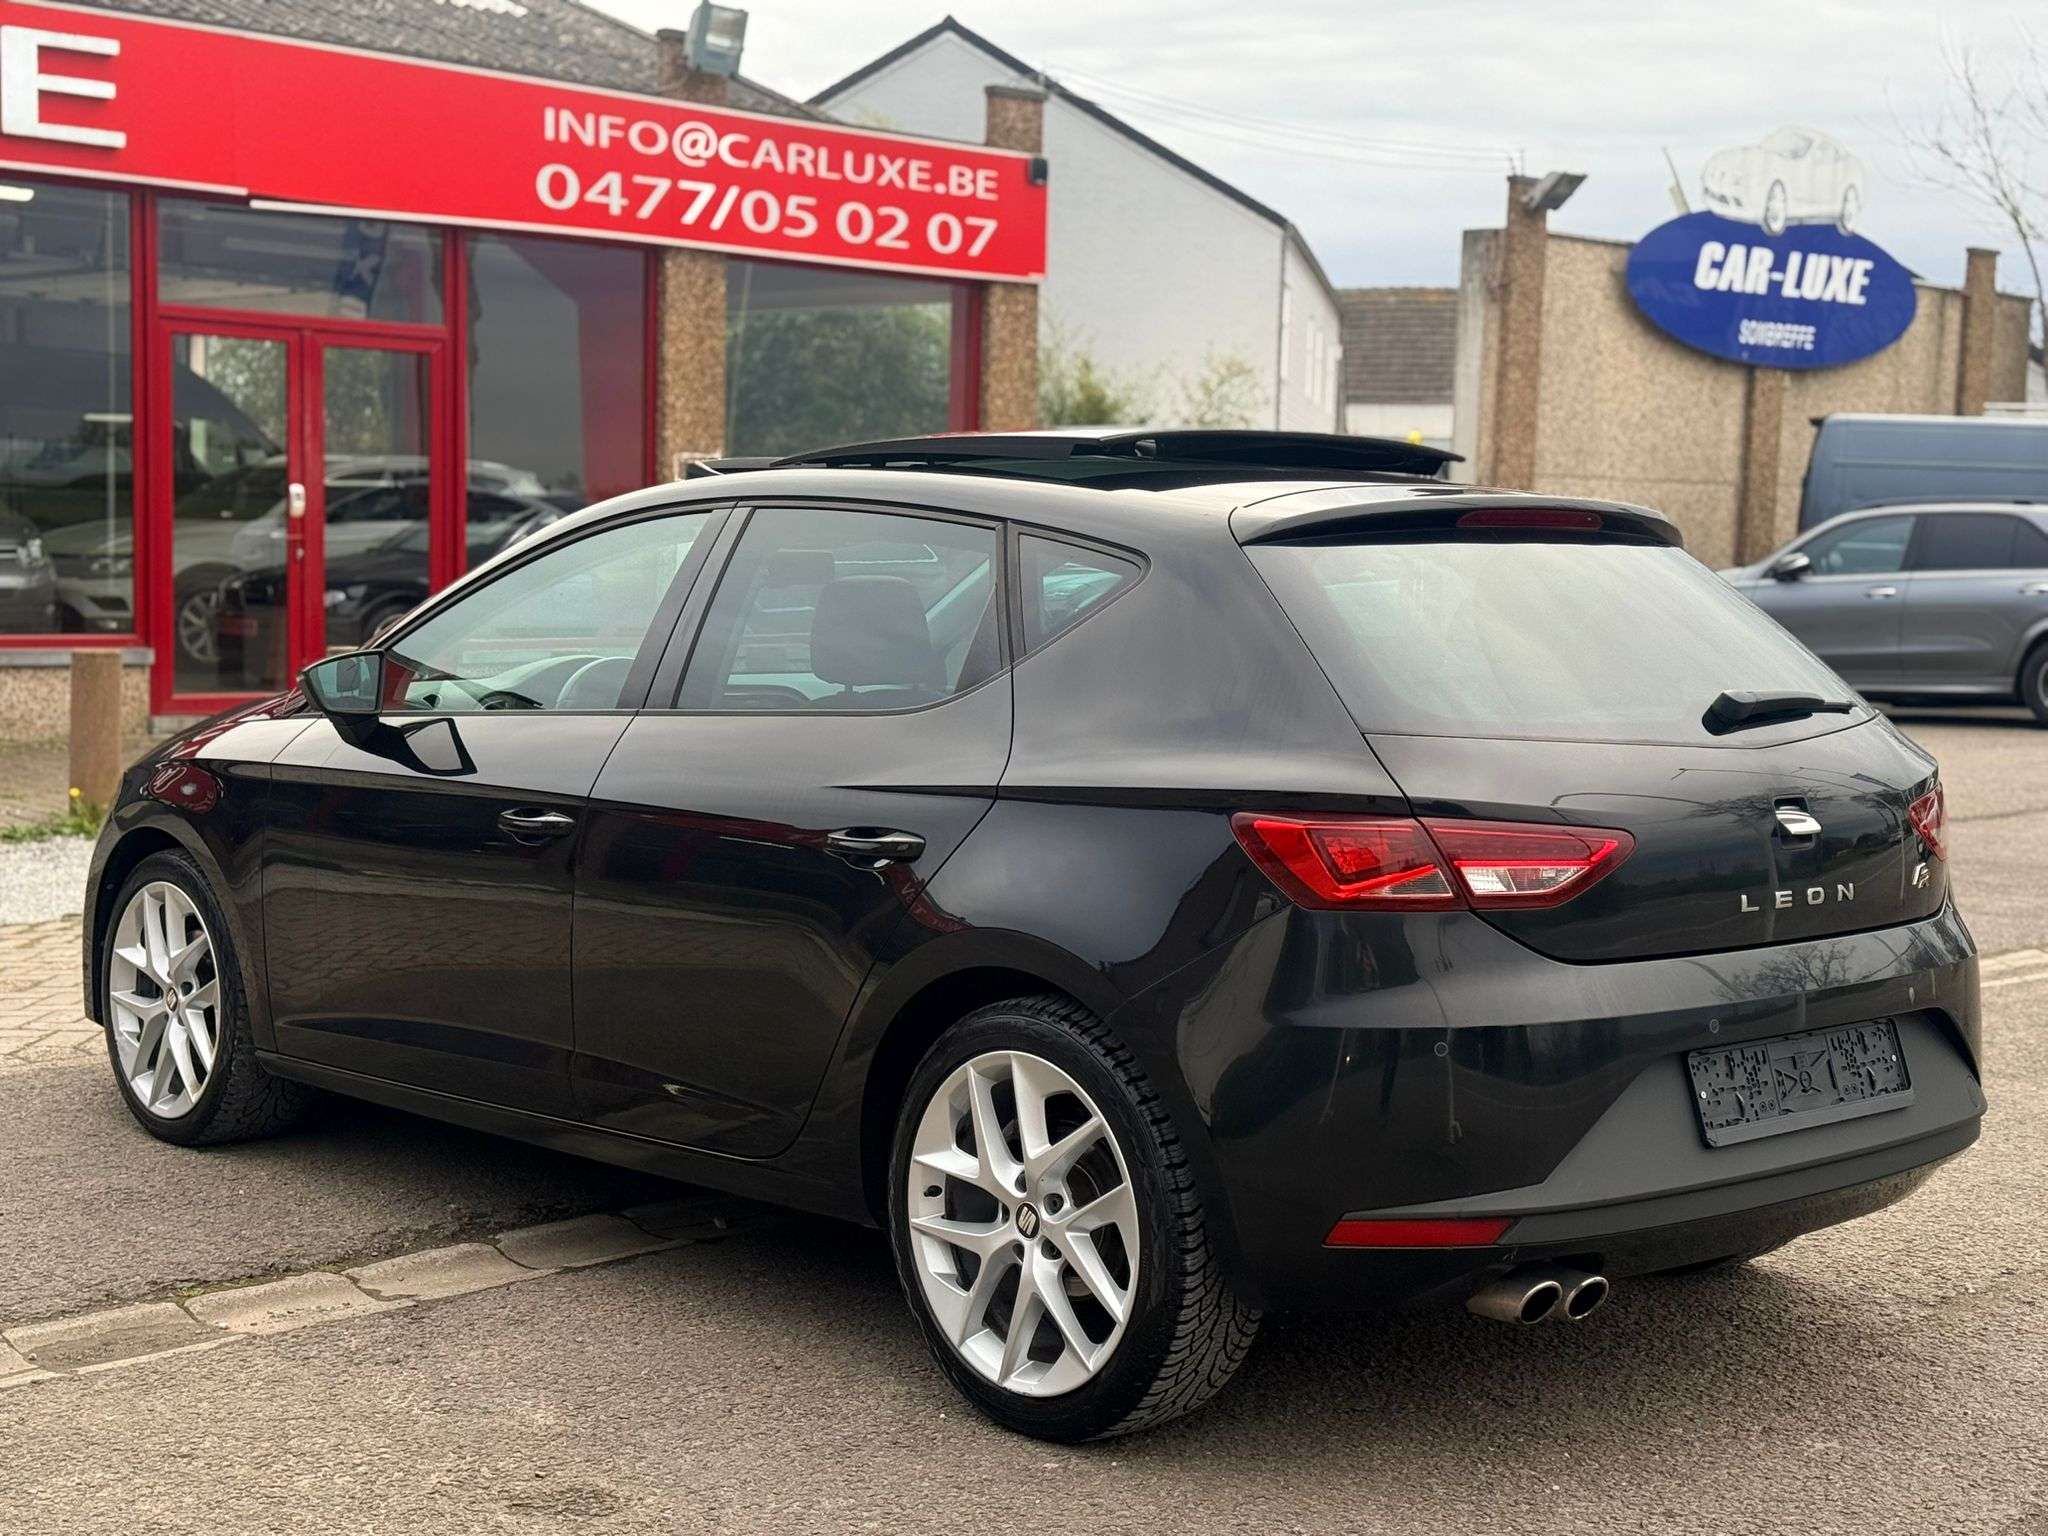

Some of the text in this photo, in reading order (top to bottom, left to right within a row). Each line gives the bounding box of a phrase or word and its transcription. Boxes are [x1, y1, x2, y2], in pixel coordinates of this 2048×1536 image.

[543, 107, 999, 201] INFO@CARLUXE.BE
[535, 163, 998, 257] 0477/05 02 07
[1693, 240, 1874, 306] CAR-LUXE
[1740, 882, 1855, 913] LEON
